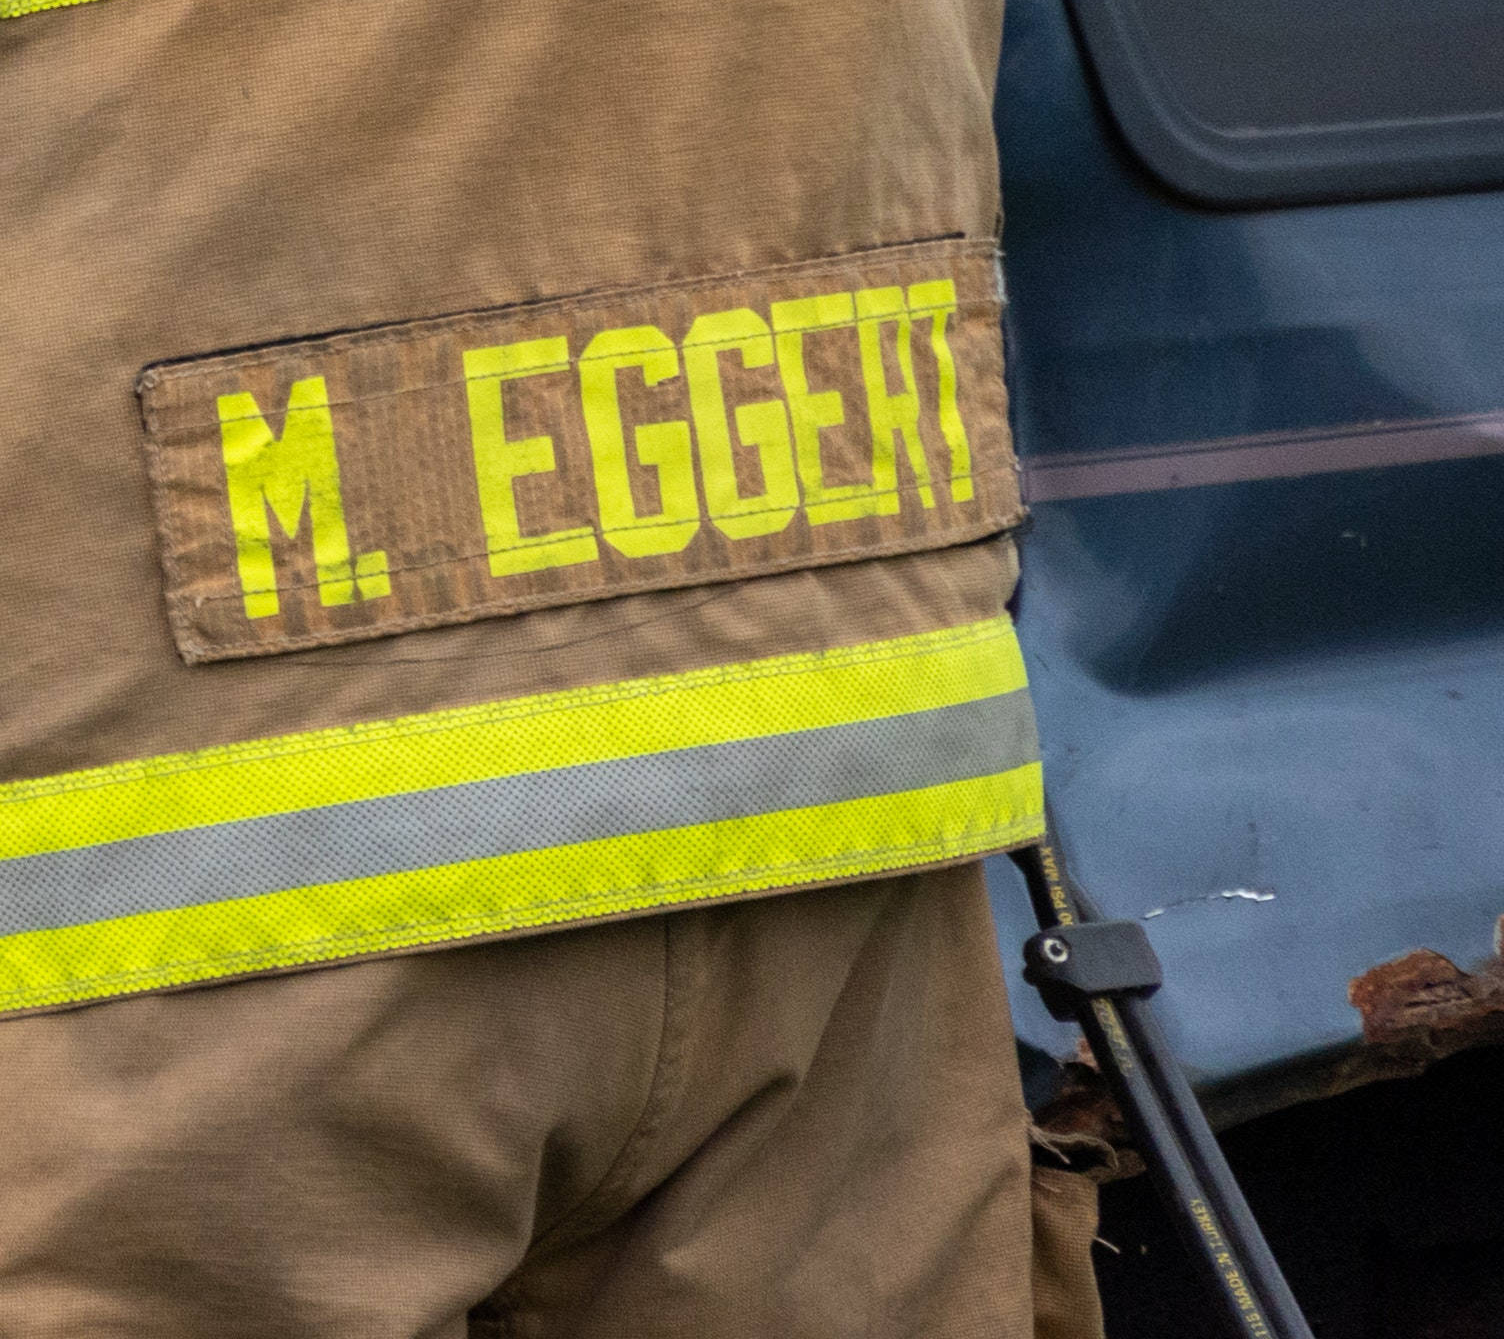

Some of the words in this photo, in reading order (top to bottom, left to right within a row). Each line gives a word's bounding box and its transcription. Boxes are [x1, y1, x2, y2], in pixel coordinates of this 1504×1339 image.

[216, 375, 392, 621] M.
[462, 277, 976, 579] EGGERT
[1039, 846, 1060, 882] MAX
[1050, 885, 1067, 910] PSI
[1189, 1198, 1224, 1251] TURKEY
[1216, 1251, 1234, 1269] IN
[1224, 1268, 1255, 1312] MADE
